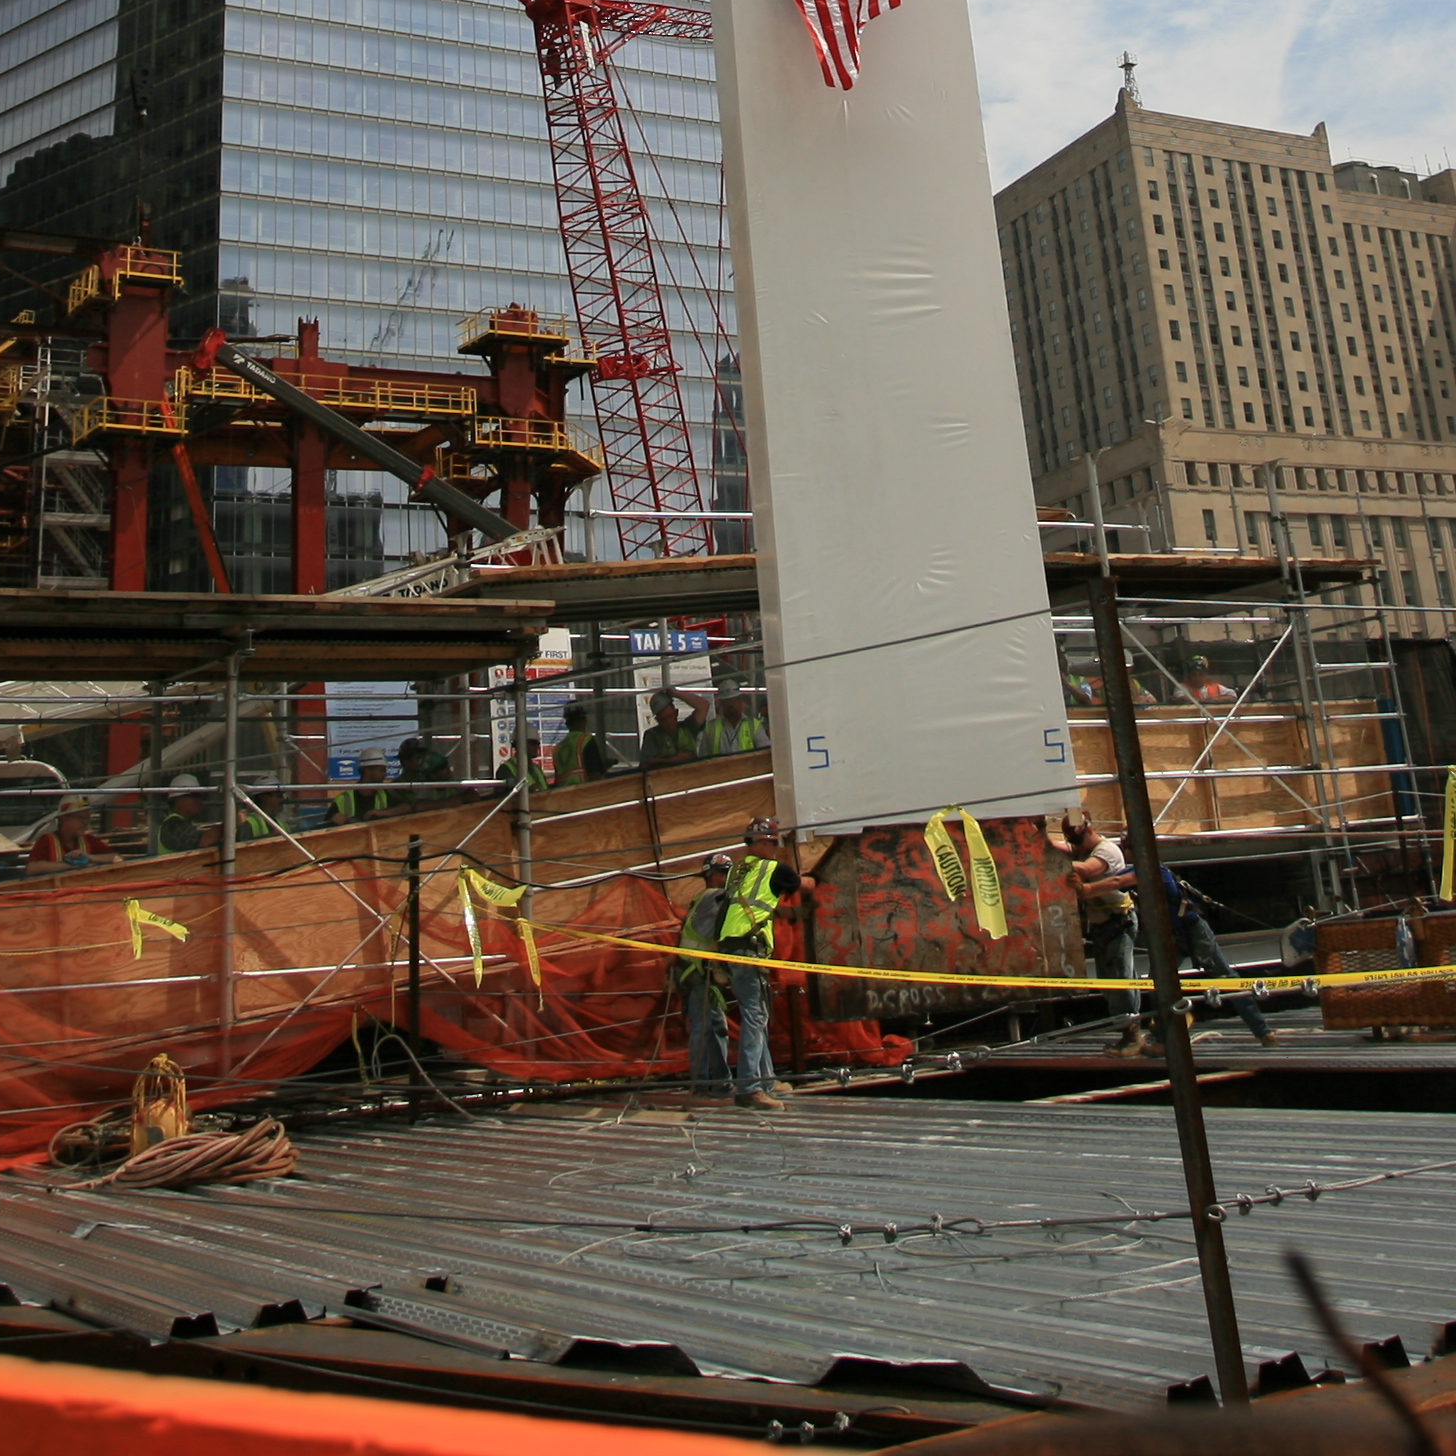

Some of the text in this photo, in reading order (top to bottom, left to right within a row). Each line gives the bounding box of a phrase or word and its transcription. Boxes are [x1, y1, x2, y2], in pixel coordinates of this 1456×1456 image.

[246, 361, 276, 384] TADANO
[678, 633, 686, 651] 5
[545, 650, 568, 659] FIRST
[935, 844, 966, 896] CAUTION
